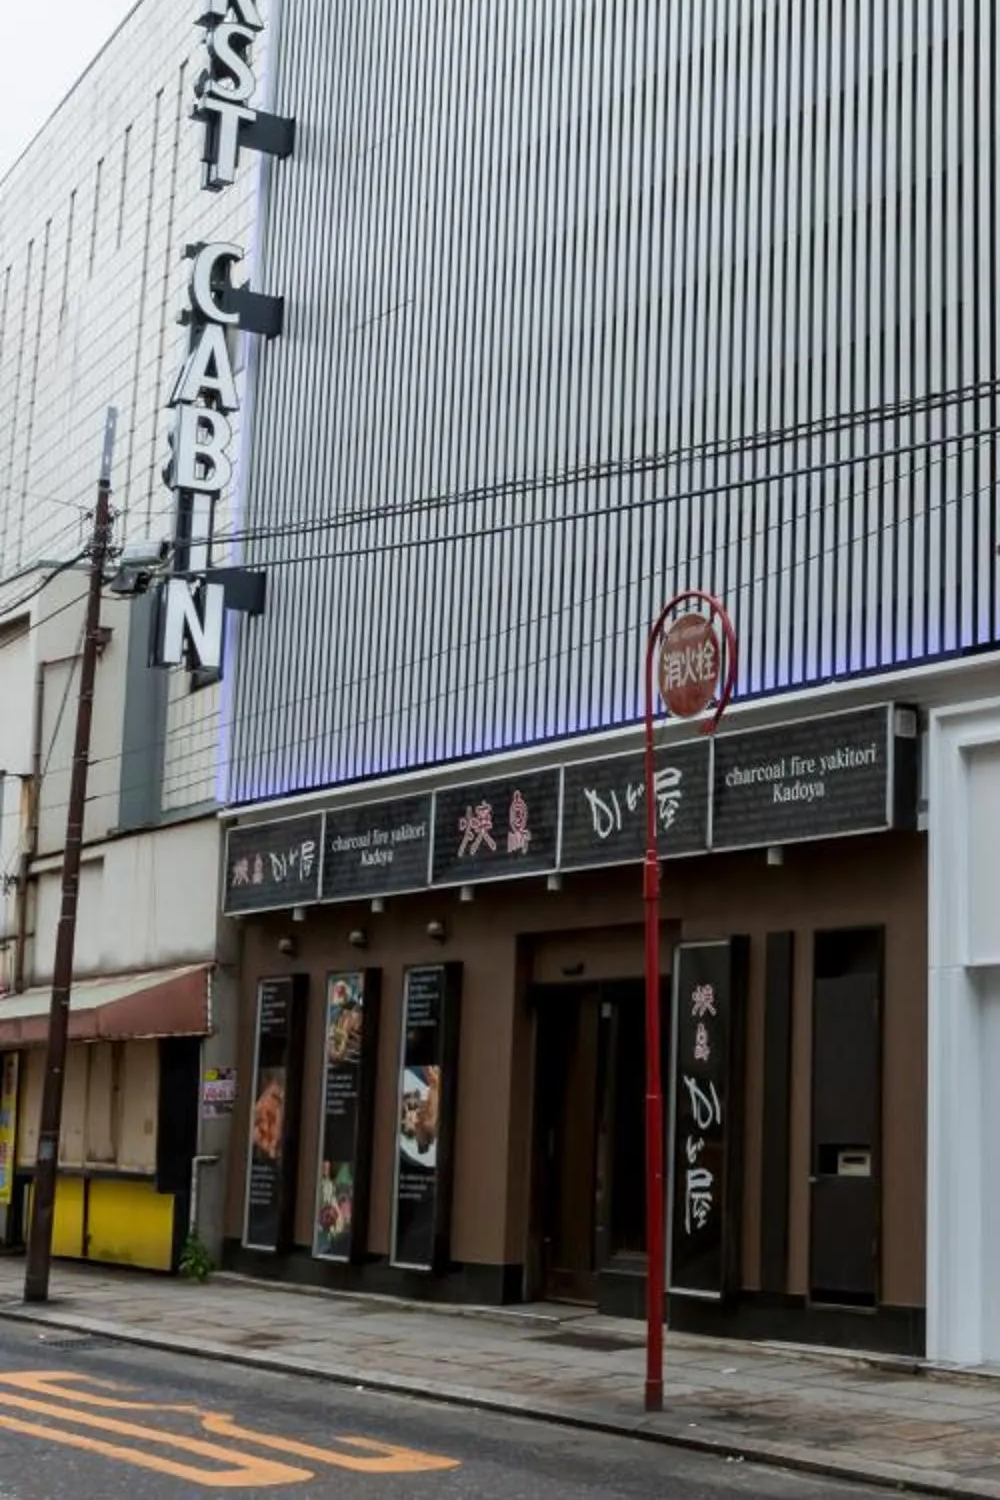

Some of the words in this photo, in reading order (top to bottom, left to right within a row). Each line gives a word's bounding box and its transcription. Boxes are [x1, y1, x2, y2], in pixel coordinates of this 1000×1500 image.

[160, 241, 244, 670] CABIN
[663, 642, 716, 691] 消火栓
[725, 760, 786, 787] charcoal
[790, 755, 815, 777] fire
[819, 743, 877, 771] yakitori
[772, 781, 825, 804] Kadoya
[331, 829, 371, 853] charcoal
[373, 826, 389, 847] fire
[360, 849, 394, 868] Kadoya
